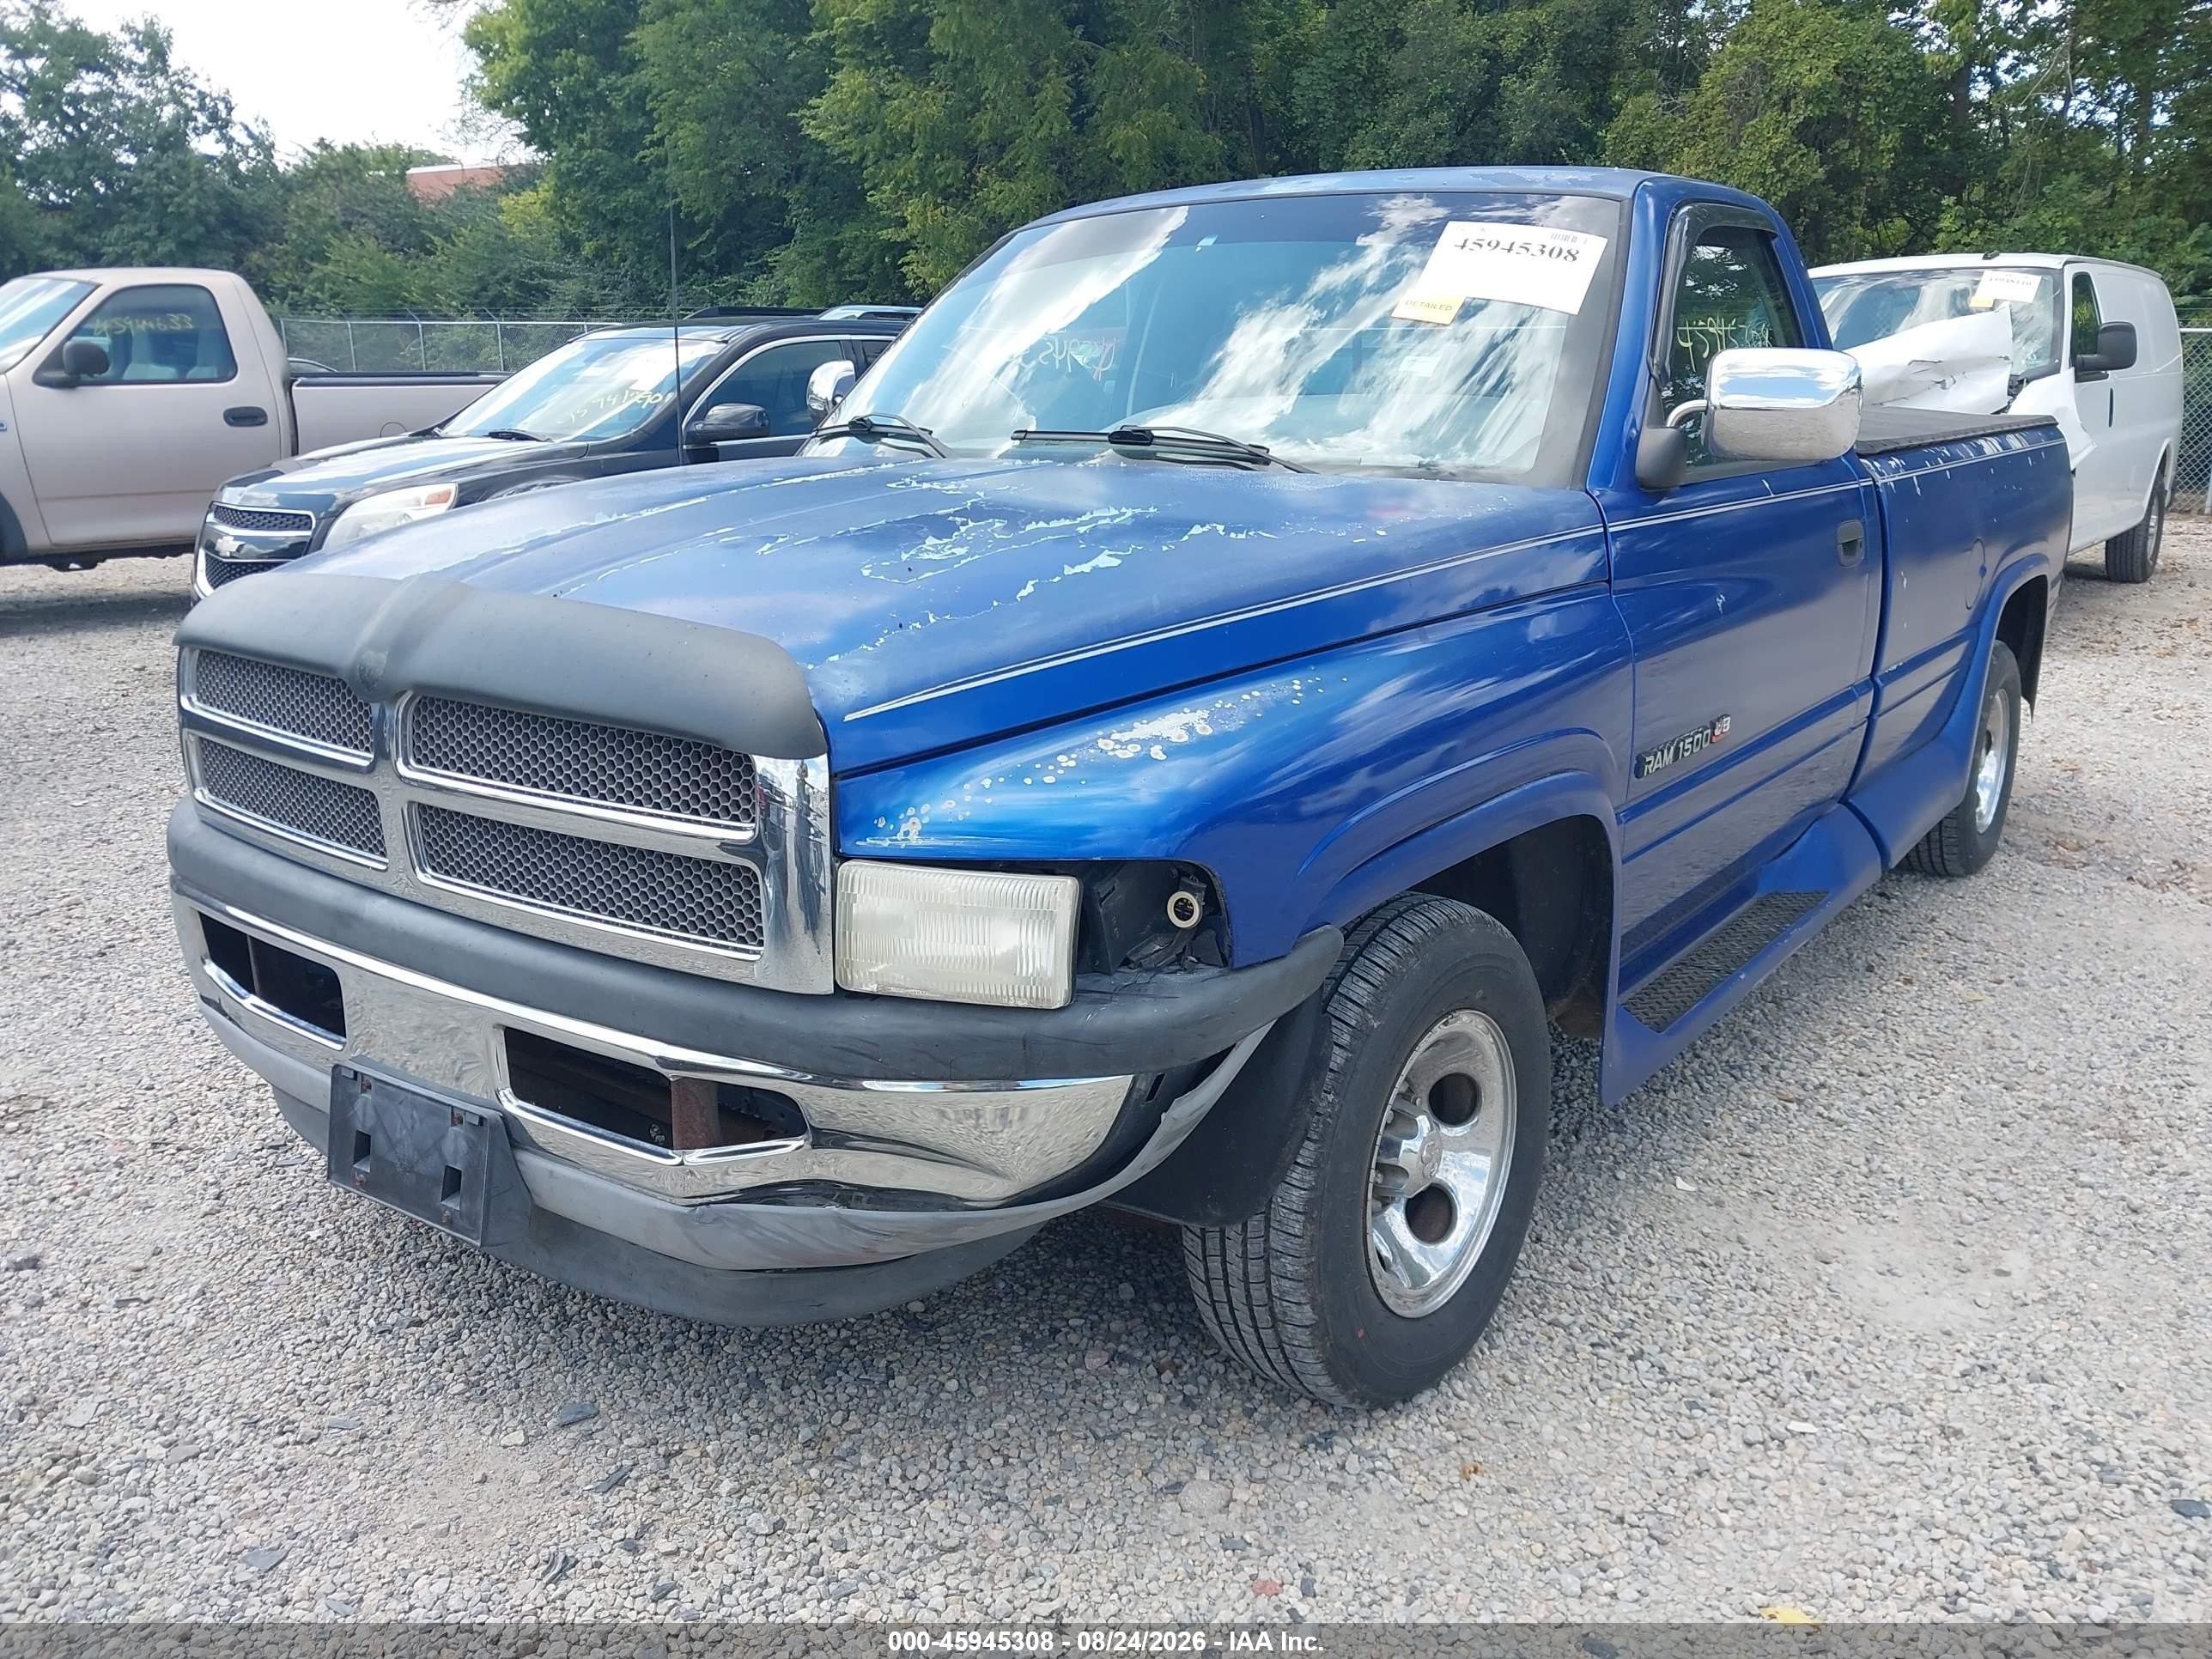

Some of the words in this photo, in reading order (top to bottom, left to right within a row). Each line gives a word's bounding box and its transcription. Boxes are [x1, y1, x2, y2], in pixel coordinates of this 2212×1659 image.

[1454, 238, 1580, 262] 45945308
[1405, 299, 1453, 312] DETAILED
[1644, 744, 1675, 776] RAM
[1677, 728, 1711, 761] 1500
